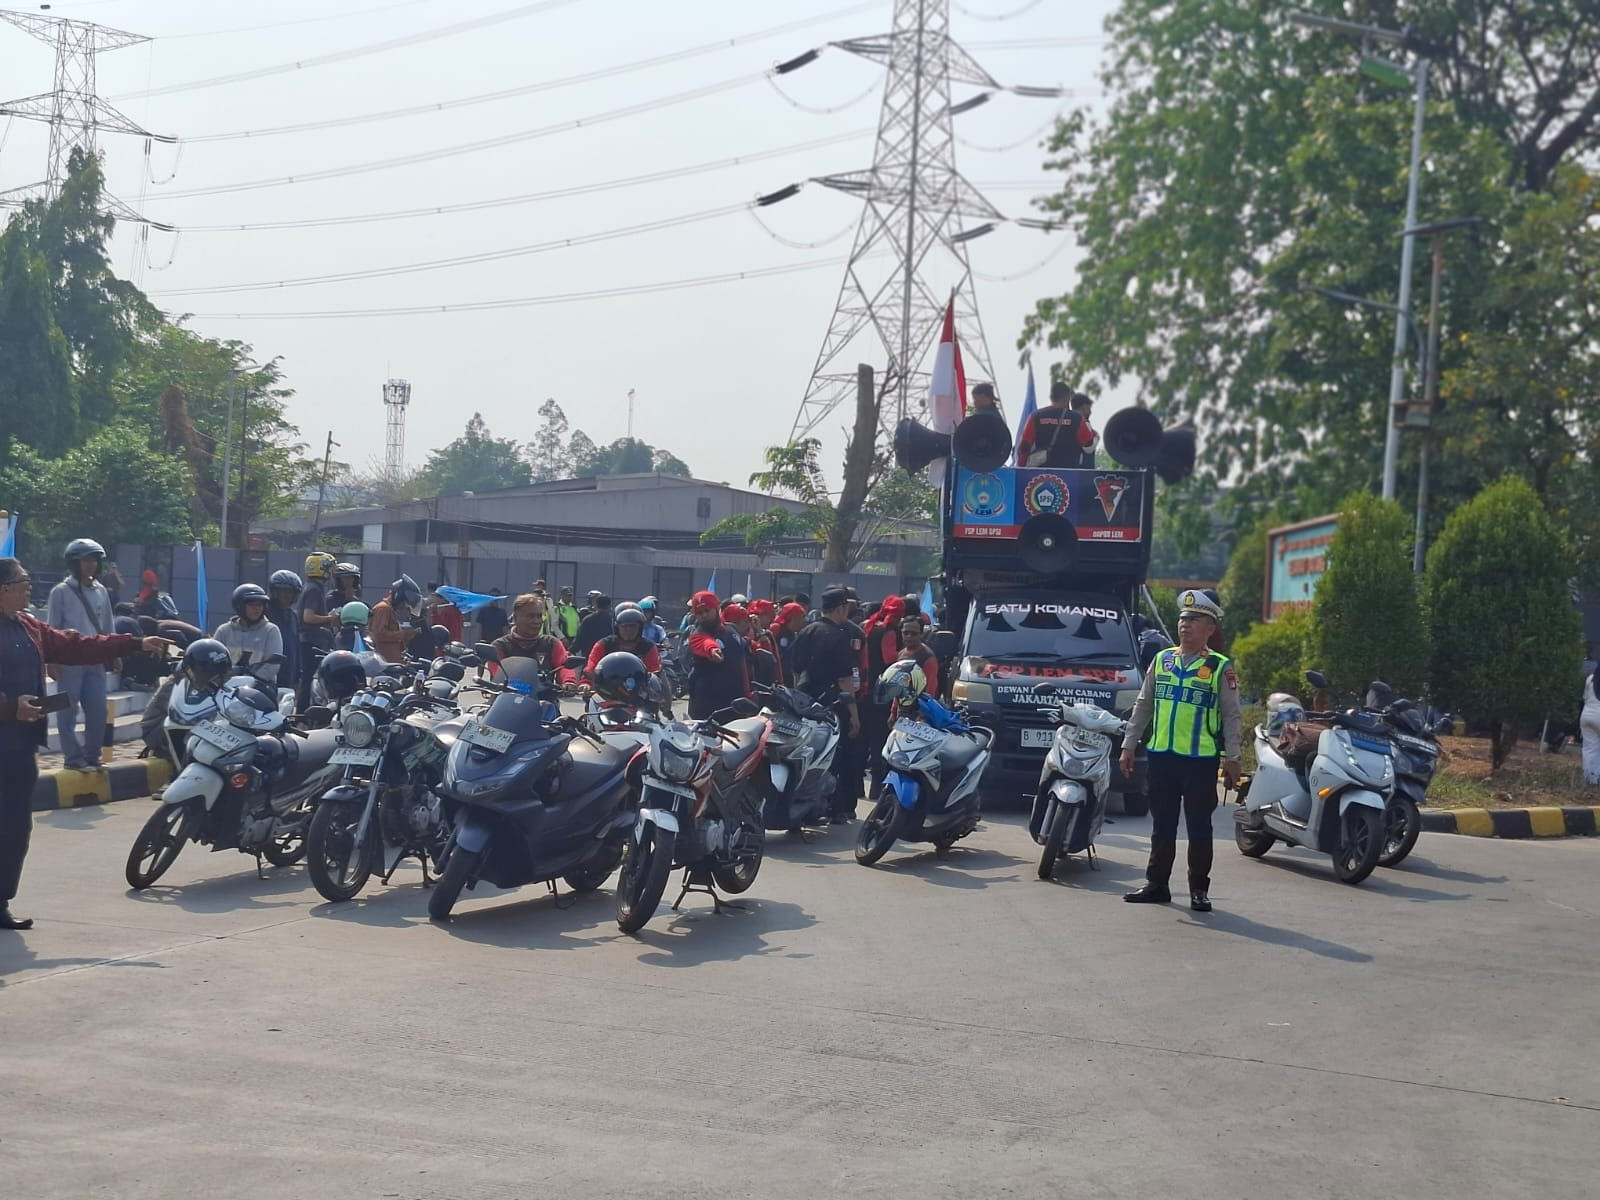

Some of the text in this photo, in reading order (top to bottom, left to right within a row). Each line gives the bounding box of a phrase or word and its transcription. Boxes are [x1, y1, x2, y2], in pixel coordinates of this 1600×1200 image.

[985, 603, 1118, 620] SATU KOMANDO
[1029, 666, 1073, 678] LEM
[997, 685, 1029, 694] DEWAN
[1075, 689, 1111, 699] CABANG
[1012, 693, 1060, 705] JAKARTA
[1036, 731, 1056, 742] 911
